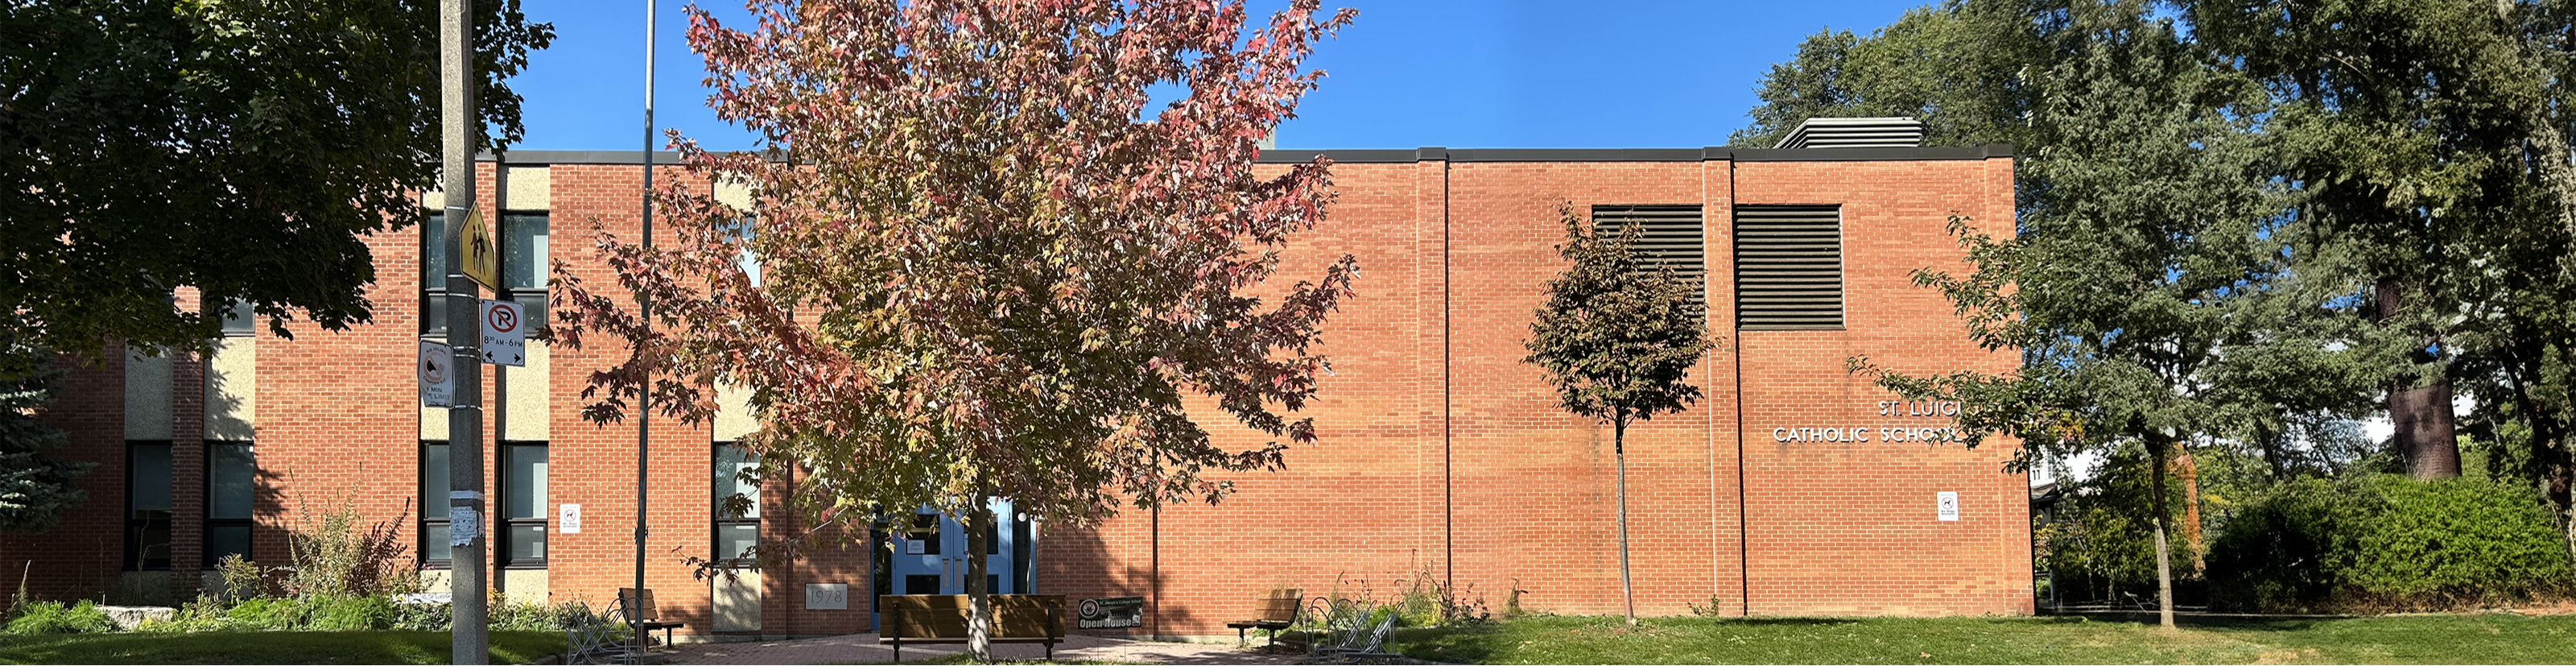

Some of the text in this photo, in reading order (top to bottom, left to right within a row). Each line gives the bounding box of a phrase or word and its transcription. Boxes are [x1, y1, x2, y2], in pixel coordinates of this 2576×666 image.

[508, 338, 514, 347] 6
[433, 346, 447, 355] IDLING
[1879, 400, 1963, 416] ST. LUIGI
[1773, 427, 1963, 442] CATHOLIC SCHOOL
[811, 590, 842, 603] 1978
[1080, 618, 1132, 628] Open House
